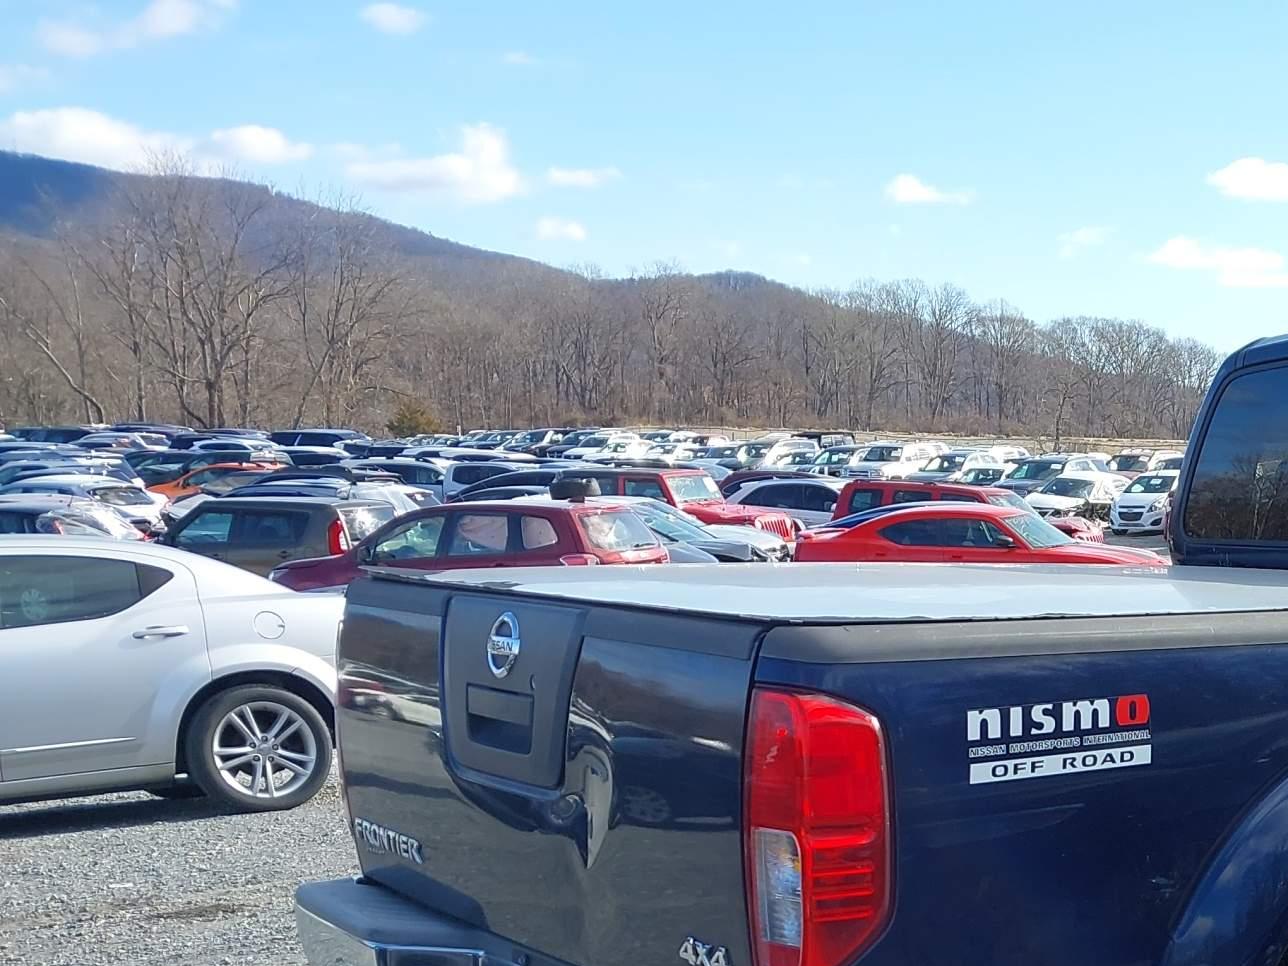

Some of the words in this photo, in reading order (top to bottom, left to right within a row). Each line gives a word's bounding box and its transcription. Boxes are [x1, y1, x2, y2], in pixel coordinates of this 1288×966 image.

[969, 744, 1007, 758] NISSAN
[1009, 737, 1081, 754] MOTORSPORTS
[1083, 730, 1151, 746] INTERNATIONAL
[991, 759, 1045, 778] OFF
[1062, 750, 1135, 770] ROAD
[354, 816, 423, 864] FRONTIER
